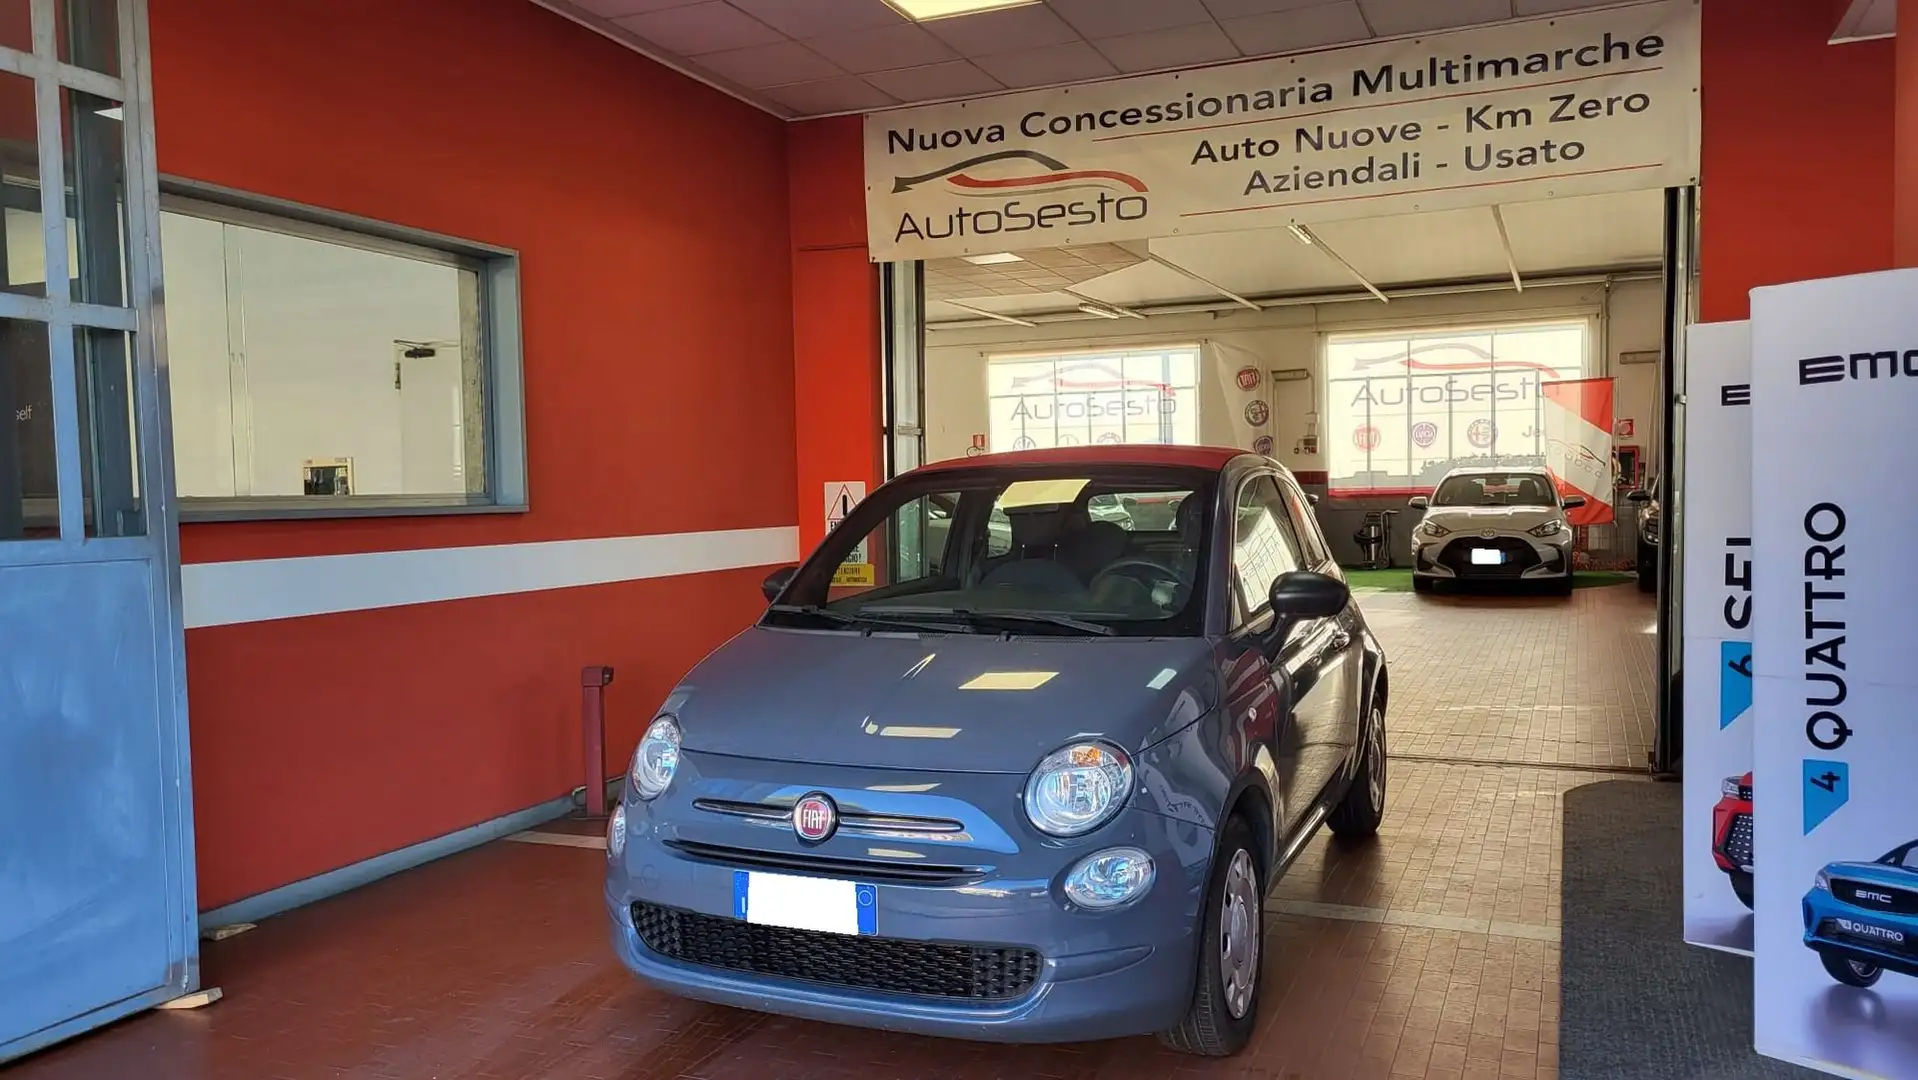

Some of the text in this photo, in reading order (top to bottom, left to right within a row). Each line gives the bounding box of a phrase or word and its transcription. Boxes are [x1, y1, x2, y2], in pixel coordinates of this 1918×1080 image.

[888, 32, 1665, 154] Nuova Concessionaria Multimarche
[1191, 138, 1280, 165] Auto
[1296, 122, 1422, 153] Nuove
[1466, 104, 1532, 133] Km
[1549, 92, 1650, 123] Zero
[1243, 152, 1420, 195] Aziendali
[1465, 140, 1585, 172] Usato
[895, 192, 1148, 243] AutoSesto
[1011, 395, 1177, 421] AutoSesto
[1803, 502, 1853, 793] 4 QUATTRO
[803, 809, 827, 829] FIAT
[1853, 923, 1904, 941] QUATTRO
